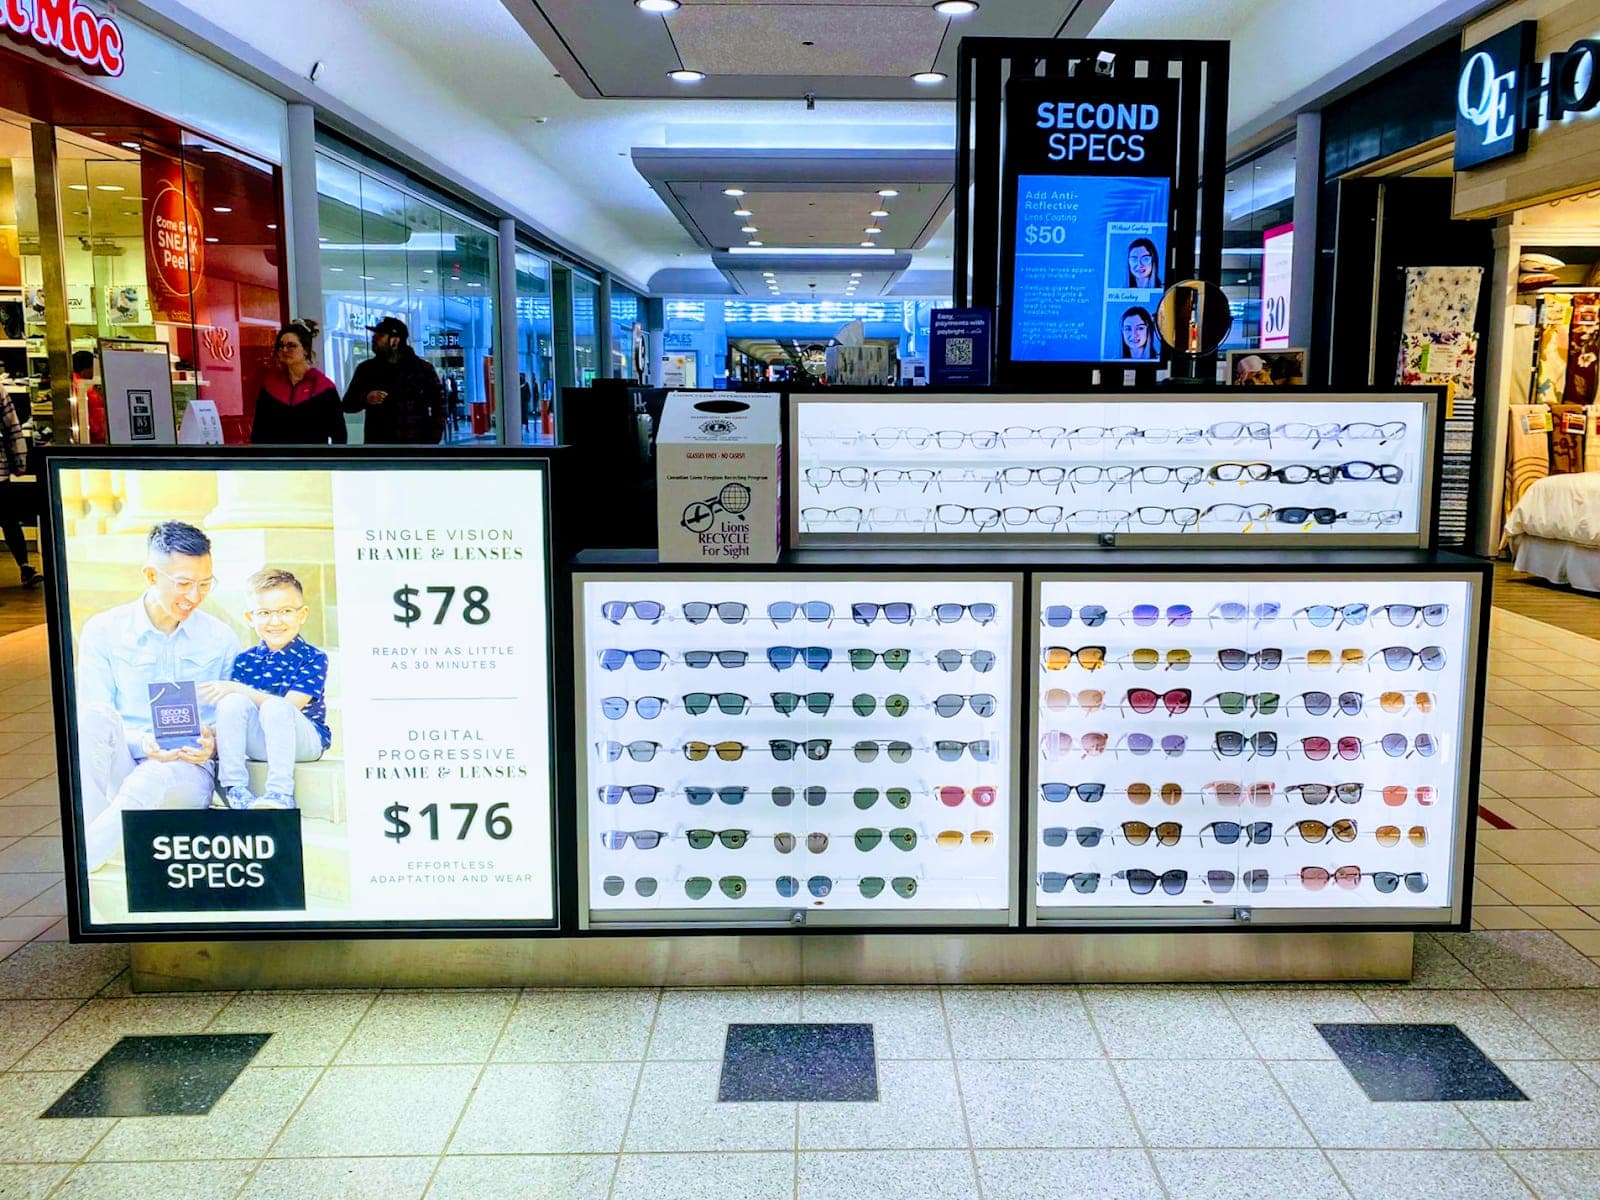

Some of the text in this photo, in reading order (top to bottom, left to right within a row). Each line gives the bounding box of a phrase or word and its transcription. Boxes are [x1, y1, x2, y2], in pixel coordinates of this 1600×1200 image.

[1458, 51, 1516, 145] QE
[1036, 102, 1159, 130] SECOND
[1047, 133, 1145, 162] SPECS
[1025, 191, 1079, 200] Add Anti-
[1024, 201, 1079, 210] Reflective
[1025, 224, 1066, 245] $50
[157, 229, 198, 255] SNEAK
[1265, 296, 1286, 333] 30
[721, 521, 750, 533] Lions
[365, 529, 513, 542] SINGLE VISION
[698, 532, 750, 544] RECYCLE
[357, 547, 524, 561] FRAME & LENSES
[702, 544, 750, 559] For Sight
[392, 584, 491, 628] $78
[372, 645, 514, 656] READY IN AS LITTLE
[391, 660, 497, 670] AS 30 MINUTES
[160, 707, 190, 717] SECOND
[161, 714, 191, 725] SPECS
[408, 729, 484, 741] DIGITAL
[378, 748, 516, 761] PROGRESSIVE
[365, 765, 528, 779] FRAME & LENSES
[383, 801, 513, 844] $176
[152, 835, 275, 861] SECOND
[407, 860, 495, 870] EFFORTLESS
[167, 863, 265, 889] SPECS
[370, 873, 532, 884] ADAPTATION AND WEAR
